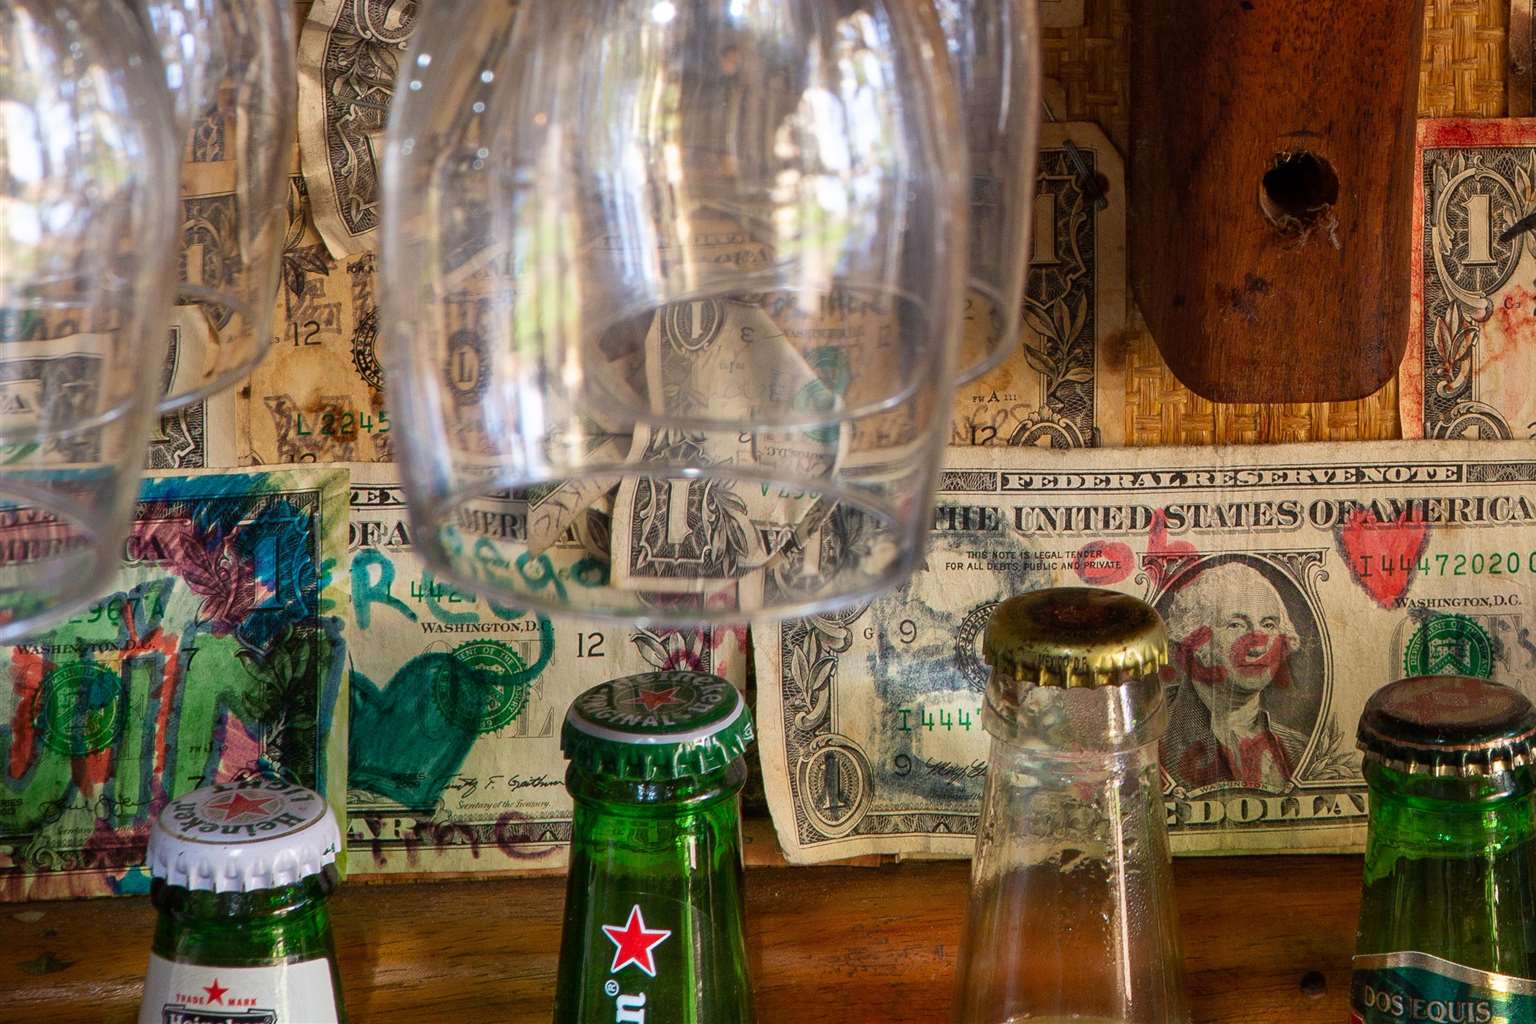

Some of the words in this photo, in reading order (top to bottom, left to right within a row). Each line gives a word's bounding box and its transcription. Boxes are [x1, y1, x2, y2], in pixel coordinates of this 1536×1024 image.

[297, 410, 392, 437] L2245
[1005, 471, 1187, 492] FEDERAL
[1187, 467, 1362, 488] RESERVE
[1364, 465, 1461, 483] NOTE
[1012, 503, 1155, 537] UNITED
[1161, 499, 1305, 534] STATES
[1307, 497, 1356, 530] OF
[944, 561, 963, 571] FOR
[965, 561, 984, 571] ALL
[1023, 561, 1058, 571] PUBLIC
[1060, 561, 1080, 570] AND
[1083, 561, 1123, 570] PRIVATE
[966, 550, 989, 560] THIS
[991, 550, 1017, 560] NOTE
[1019, 550, 1031, 559] IS
[1033, 550, 1063, 559] LEGAL
[1065, 549, 1103, 559] TENDER
[1394, 596, 1493, 609] WASHINGTON,
[1493, 594, 1523, 607] D.C.
[899, 619, 918, 644] 9
[576, 632, 606, 659] 12
[894, 753, 913, 776] 9
[1184, 793, 1369, 825] DOLLA
[1363, 984, 1405, 1017] DOS
[1409, 997, 1492, 1024] EQUIS
